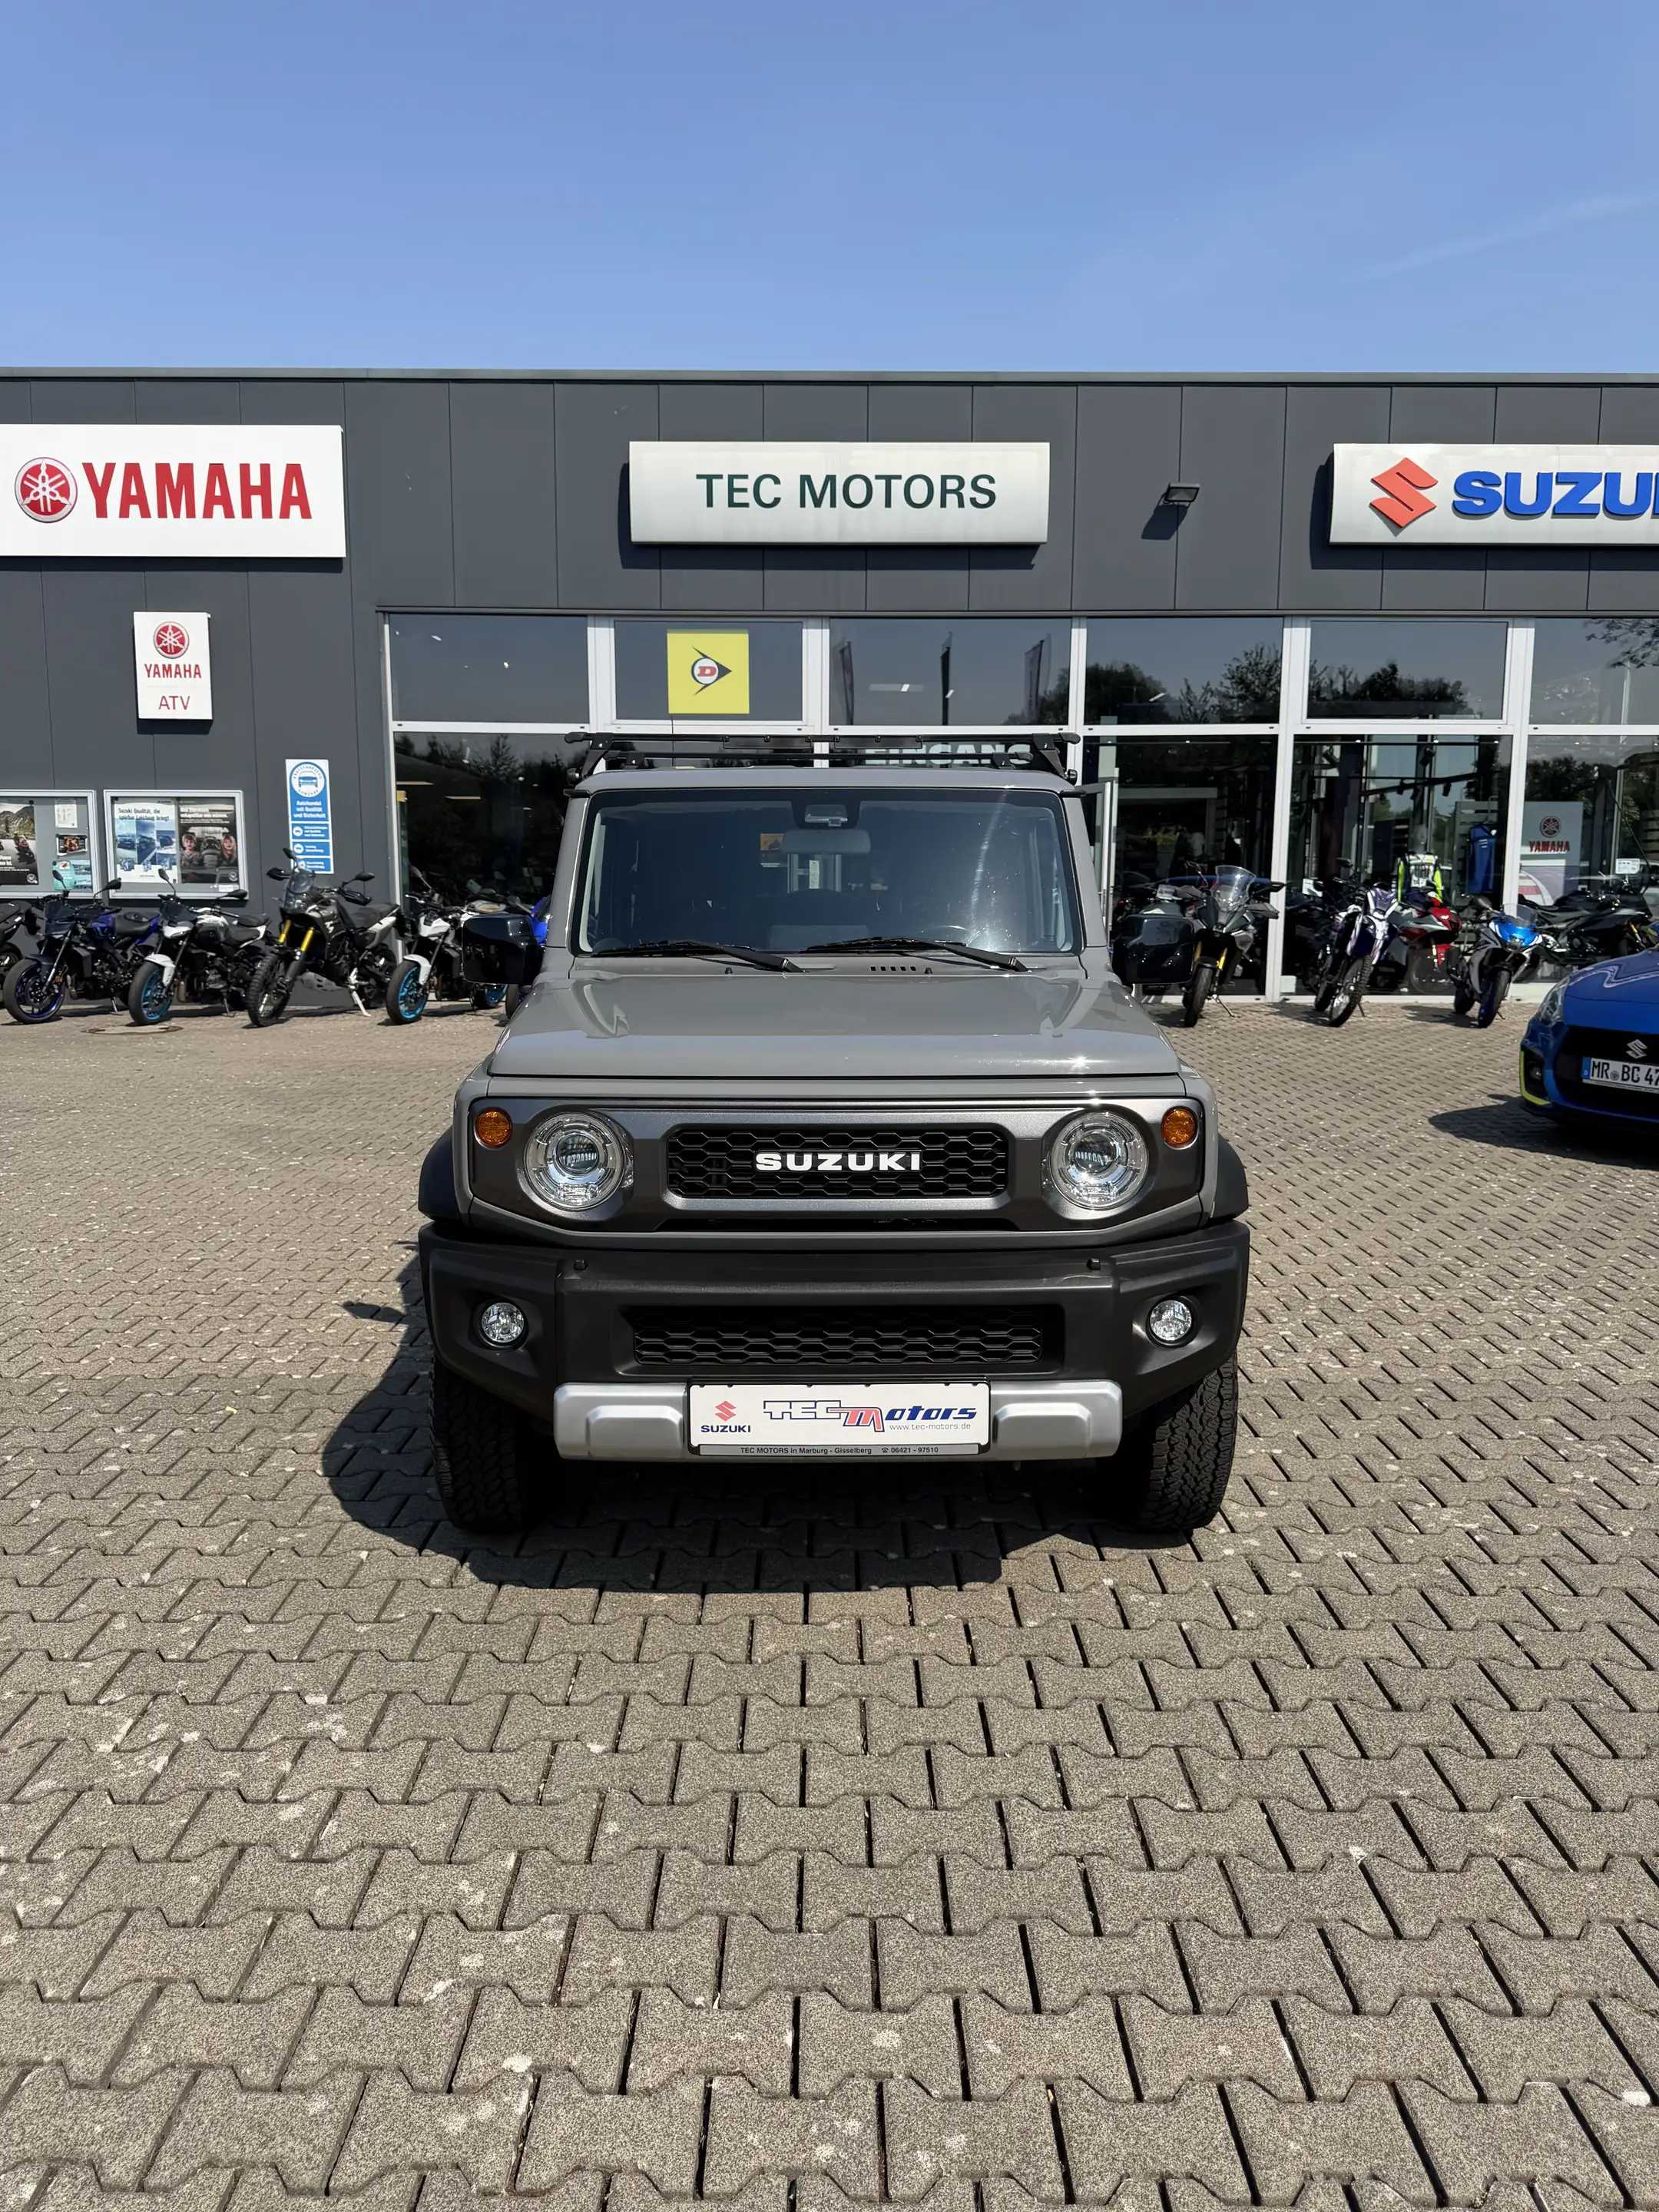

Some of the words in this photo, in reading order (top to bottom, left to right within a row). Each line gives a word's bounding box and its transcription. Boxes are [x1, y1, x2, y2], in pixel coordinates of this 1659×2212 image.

[81, 462, 313, 520] YAMAHA
[697, 474, 782, 509] TEC
[800, 474, 997, 509] MOTORS
[1452, 470, 1659, 516] SUZU
[144, 664, 202, 678] YAMAHA
[158, 695, 190, 710] ATV
[1528, 841, 1571, 853] YAMAHA
[1591, 1061, 1610, 1079] MR
[1621, 1065, 1641, 1084] BC
[756, 1153, 921, 1171] SUZUKI
[700, 1425, 751, 1433] SUZUKI
[799, 1447, 829, 1455] Marburg
[834, 1447, 872, 1455] Gisselberg
